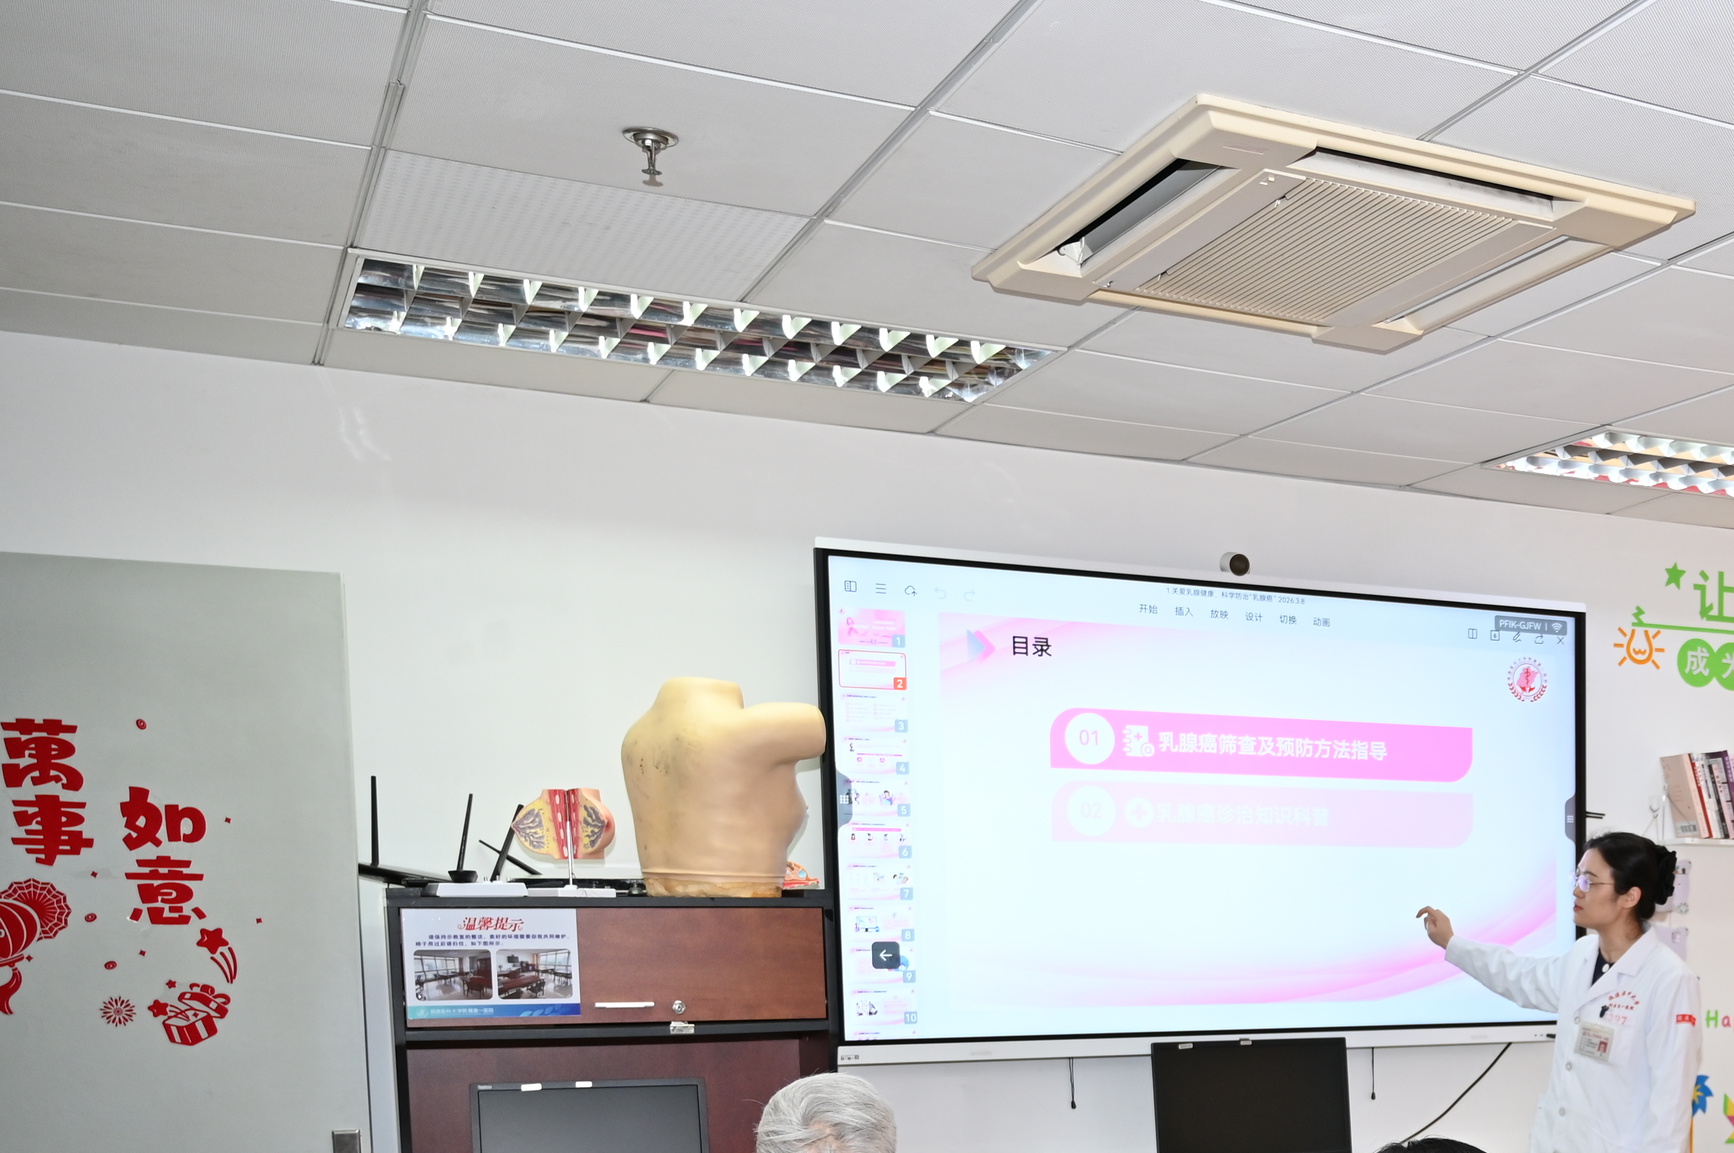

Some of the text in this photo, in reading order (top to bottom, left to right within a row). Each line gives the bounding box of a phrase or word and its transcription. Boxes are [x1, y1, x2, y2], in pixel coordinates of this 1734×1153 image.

[1139, 603, 1158, 614] 开始
[1175, 606, 1194, 617] 插入
[1210, 609, 1229, 620] 放映
[1245, 612, 1263, 622] 设计
[1279, 614, 1298, 625] 切换
[1312, 617, 1331, 628] 动画
[1010, 635, 1053, 659] 目录
[1079, 729, 1100, 747] 01
[1158, 731, 1389, 762] 乳腺癌筛查及预防方法指导
[0, 718, 94, 867] 萬事
[120, 786, 207, 925] 如意
[458, 916, 525, 932] 温馨提示
[905, 1013, 917, 1023] 10
